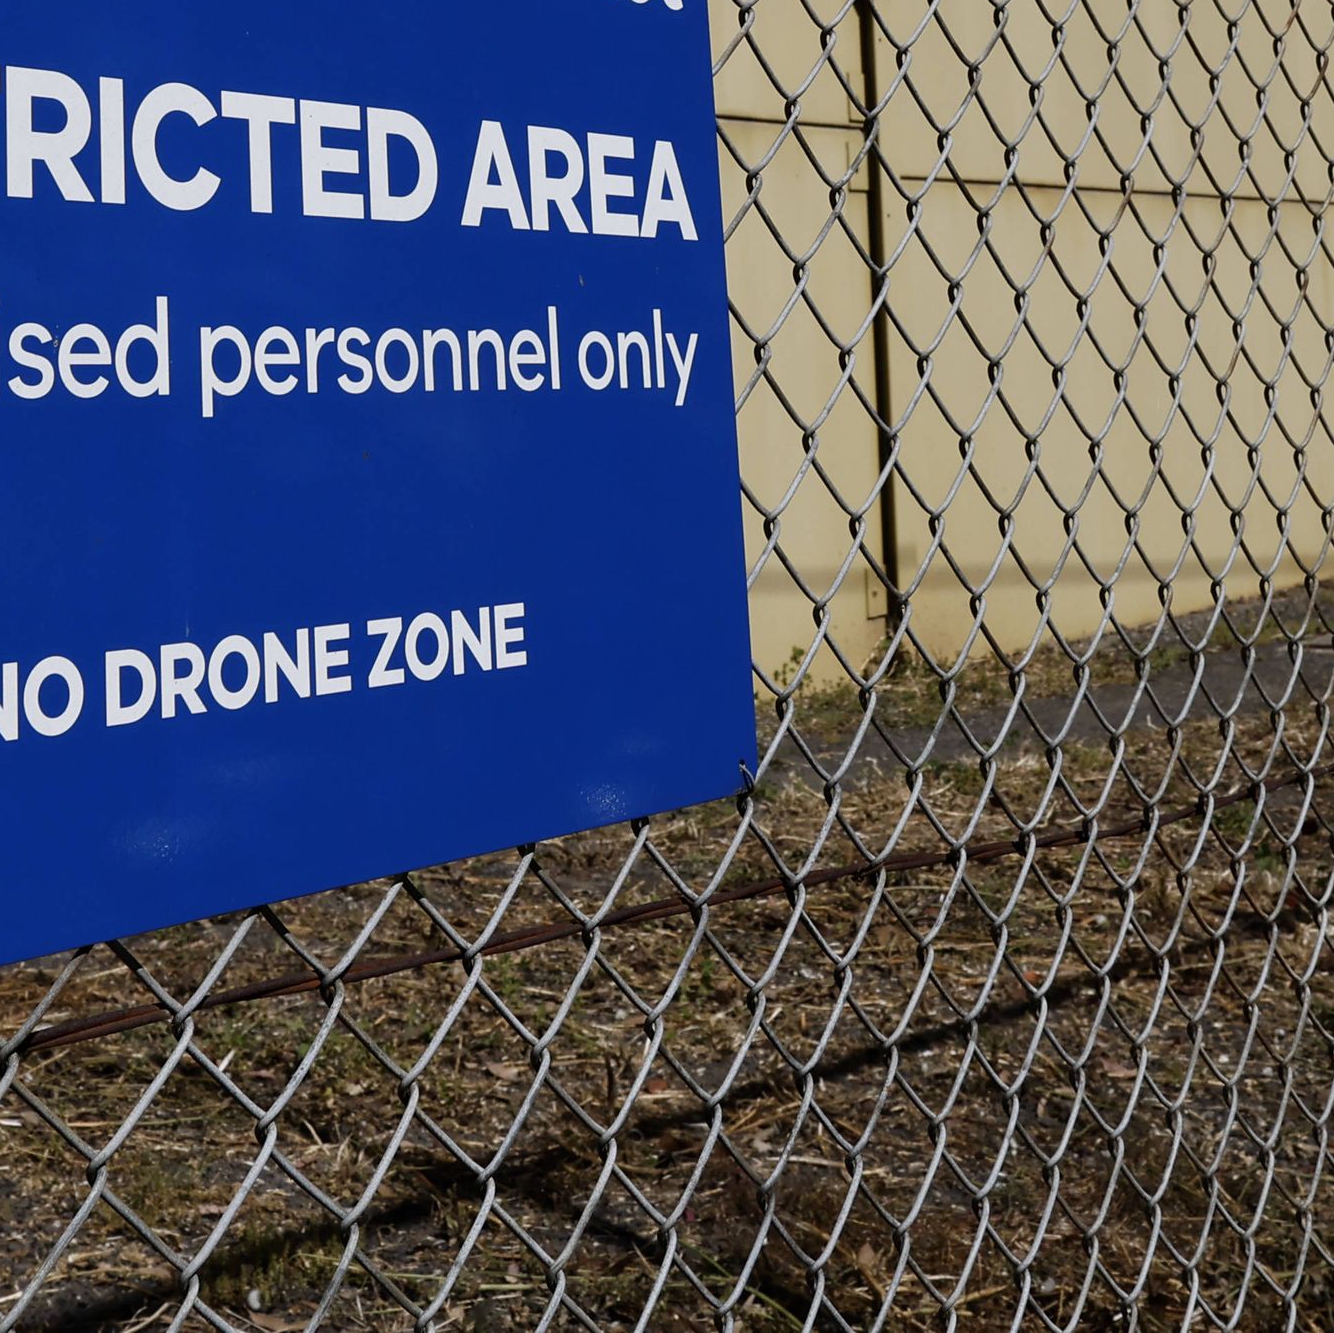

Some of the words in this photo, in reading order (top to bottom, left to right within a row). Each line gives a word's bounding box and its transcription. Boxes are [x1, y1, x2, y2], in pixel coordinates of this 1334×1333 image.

[460, 119, 699, 241] AREA
[200, 305, 561, 418] personnel
[578, 308, 699, 407] only
[105, 622, 352, 727] DRONE
[366, 602, 527, 688] ZONE
